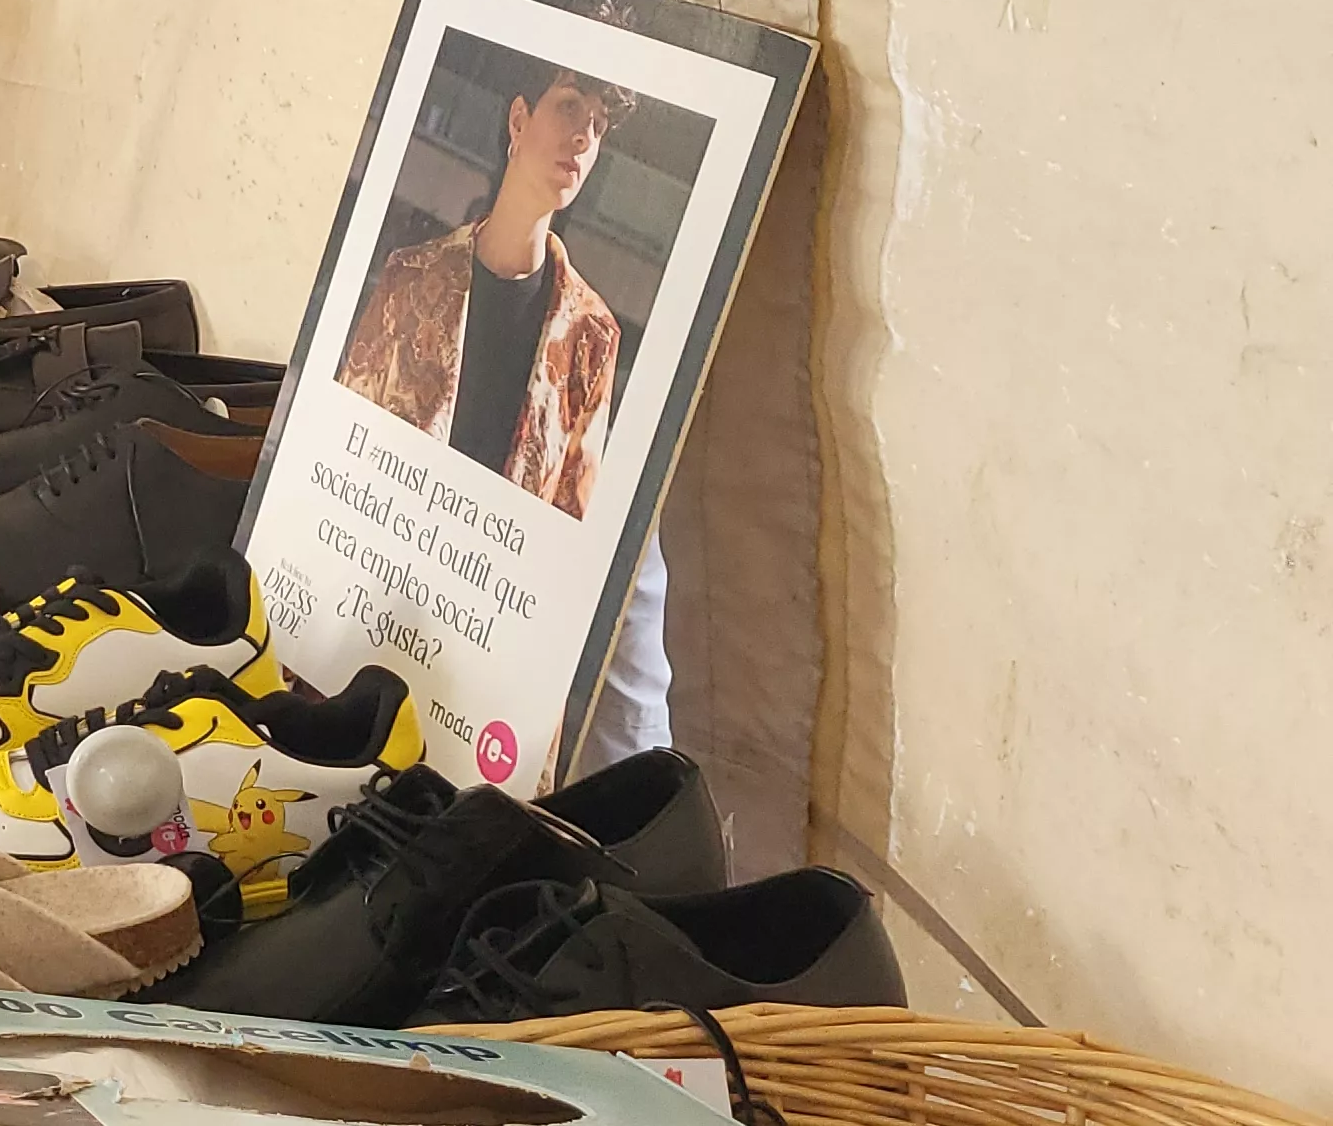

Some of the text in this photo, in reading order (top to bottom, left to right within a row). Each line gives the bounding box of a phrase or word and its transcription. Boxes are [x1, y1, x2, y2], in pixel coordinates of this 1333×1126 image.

[345, 421, 526, 556] El #must para esta
[310, 461, 537, 620] sociedad es el outfit que
[263, 566, 319, 617] DRESS
[317, 518, 495, 653] crea empleo social.
[336, 584, 443, 670] ¿Te gusta?
[428, 698, 474, 746] moda
[105, 1009, 504, 1062] Calcelimp
